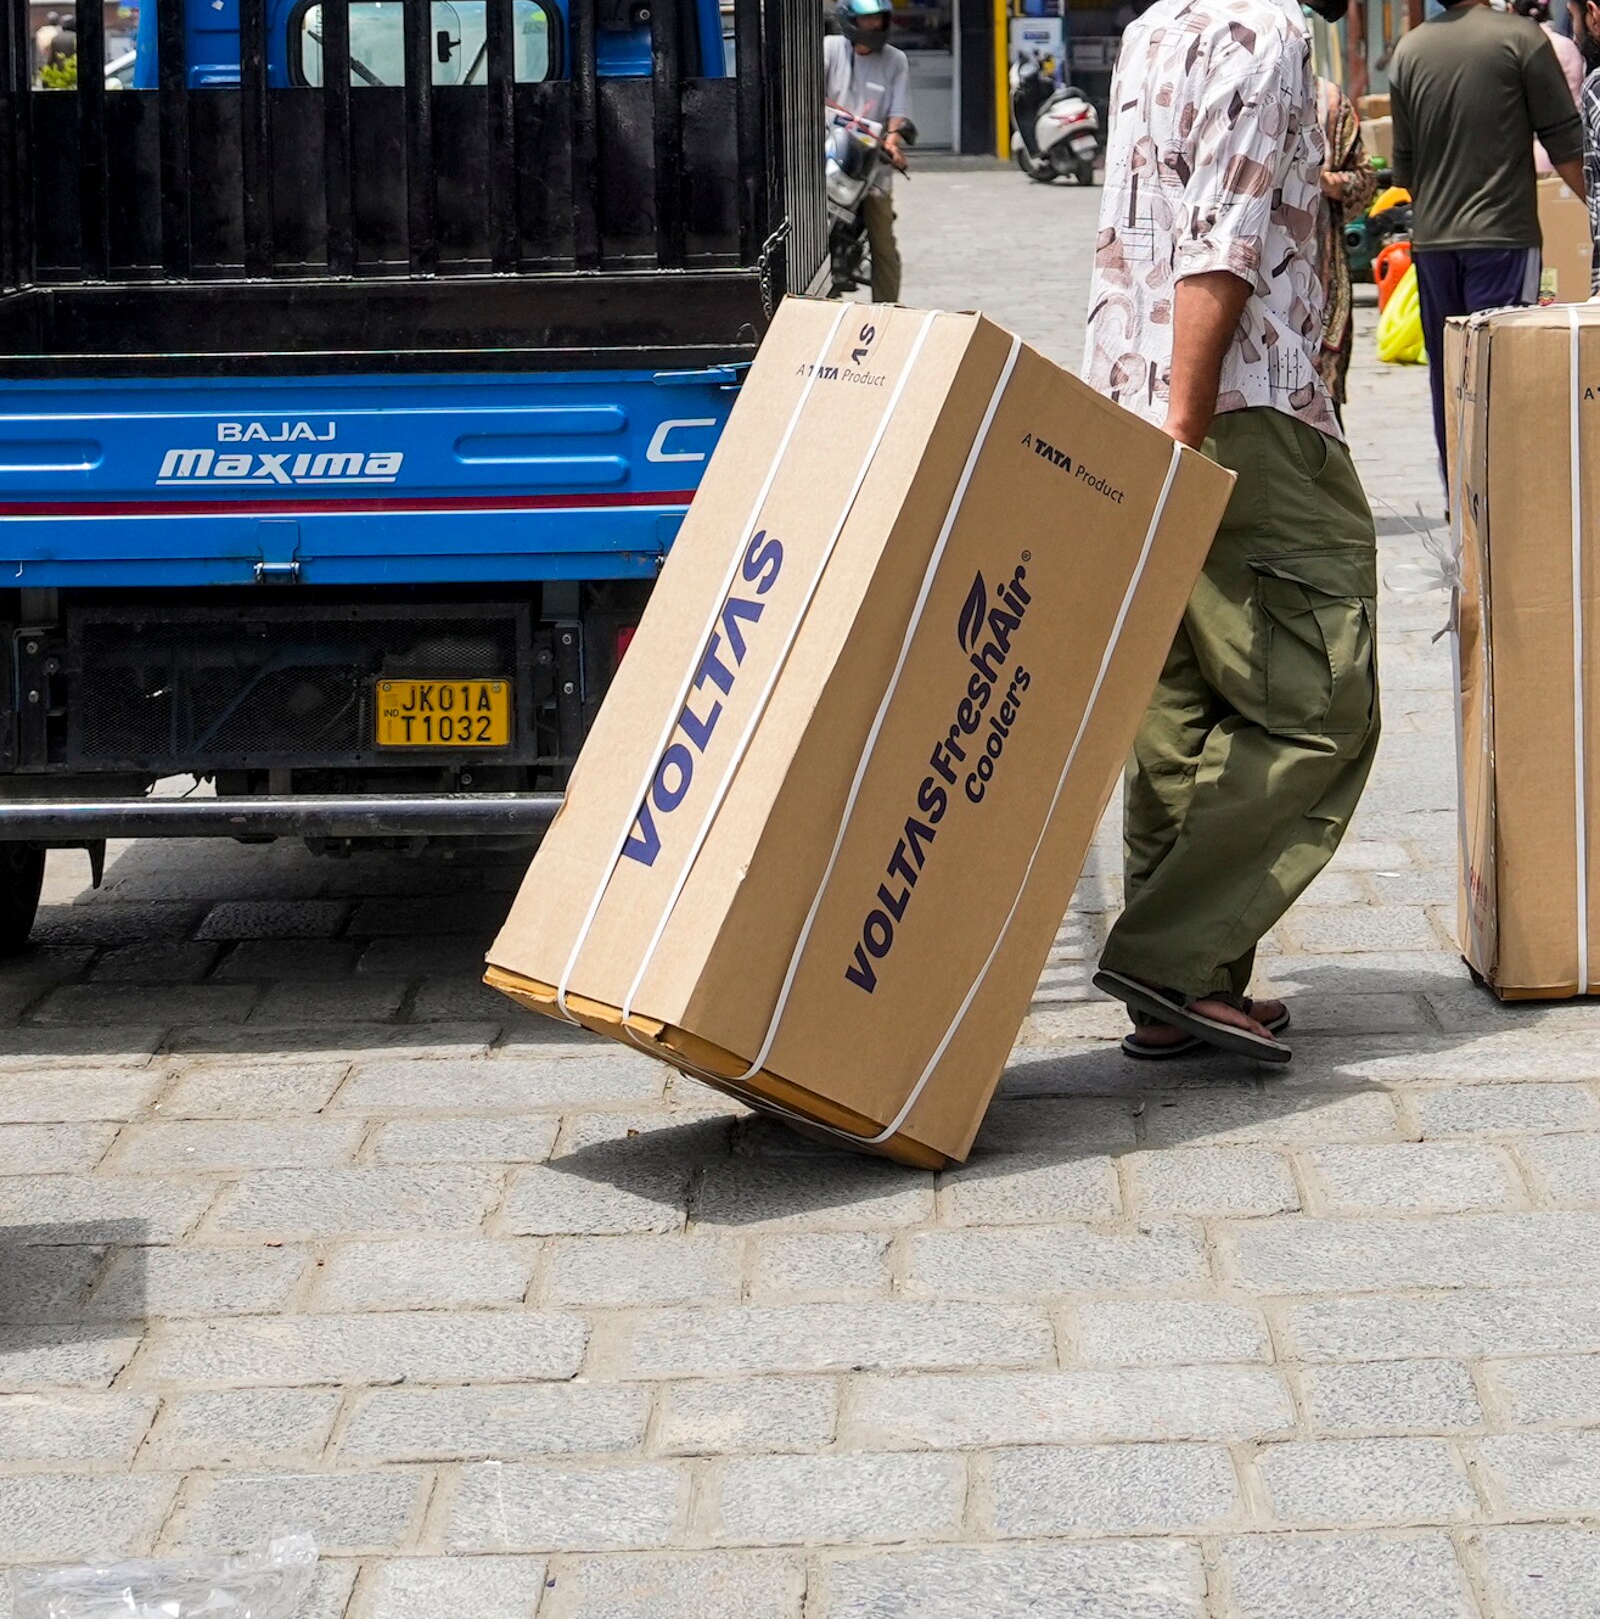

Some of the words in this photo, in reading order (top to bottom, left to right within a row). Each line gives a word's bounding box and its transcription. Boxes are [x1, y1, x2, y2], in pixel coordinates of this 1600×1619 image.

[796, 362, 806, 377] A
[808, 364, 841, 382] TATA
[842, 368, 887, 389] Product
[1584, 387, 1595, 400] A
[216, 421, 337, 443] BAJAJ
[156, 448, 405, 485] Maxima
[1020, 432, 1033, 448] A
[1034, 438, 1074, 474] TATA
[1074, 463, 1127, 506] Product
[402, 685, 492, 712] JK01A
[620, 527, 788, 871] VOLTAS
[383, 708, 400, 718] IND
[400, 715, 492, 742] T1032
[965, 664, 1032, 806] Coolers
